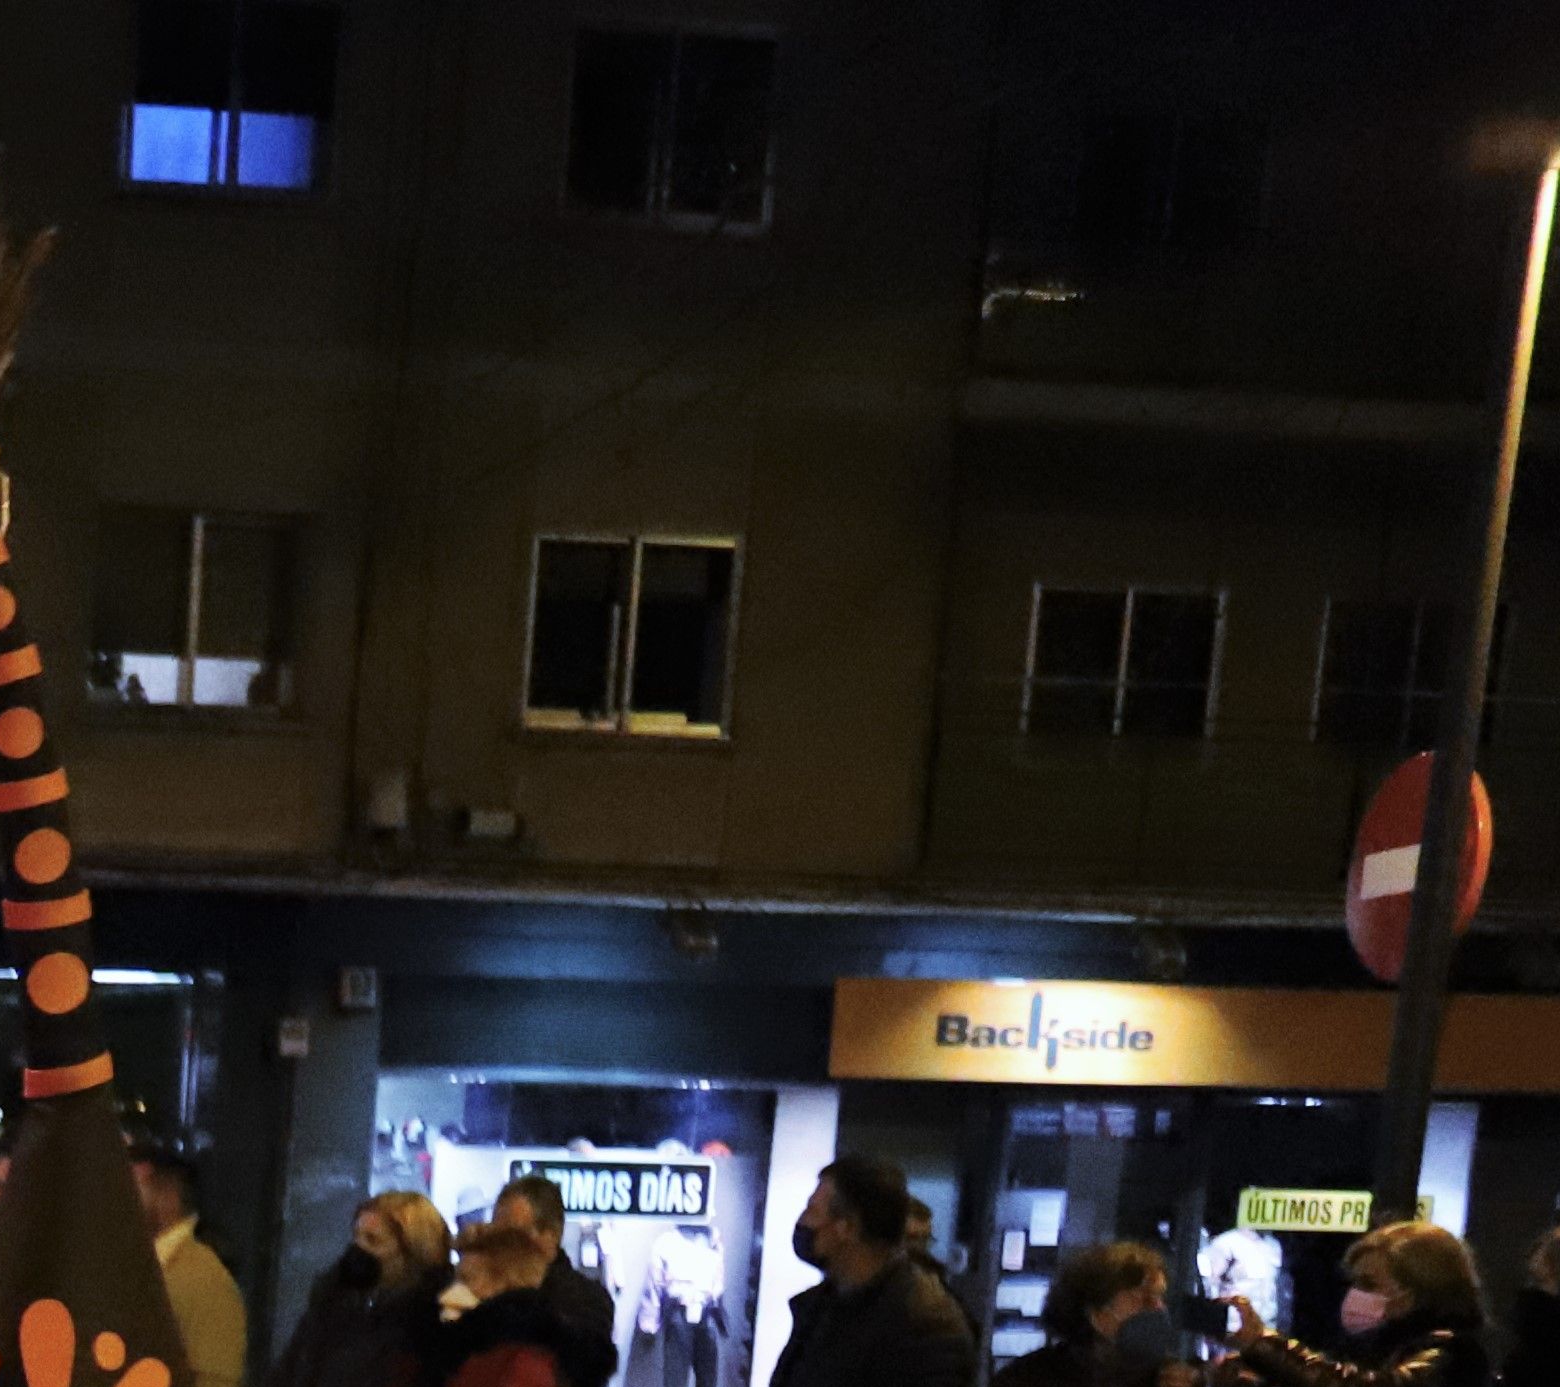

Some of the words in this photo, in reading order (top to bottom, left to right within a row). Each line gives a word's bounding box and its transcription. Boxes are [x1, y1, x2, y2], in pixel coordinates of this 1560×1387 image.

[936, 991, 1154, 1069] Backside
[638, 1166, 703, 1213] DÍAS
[1247, 1192, 1333, 1225] ÚLTIMOS
